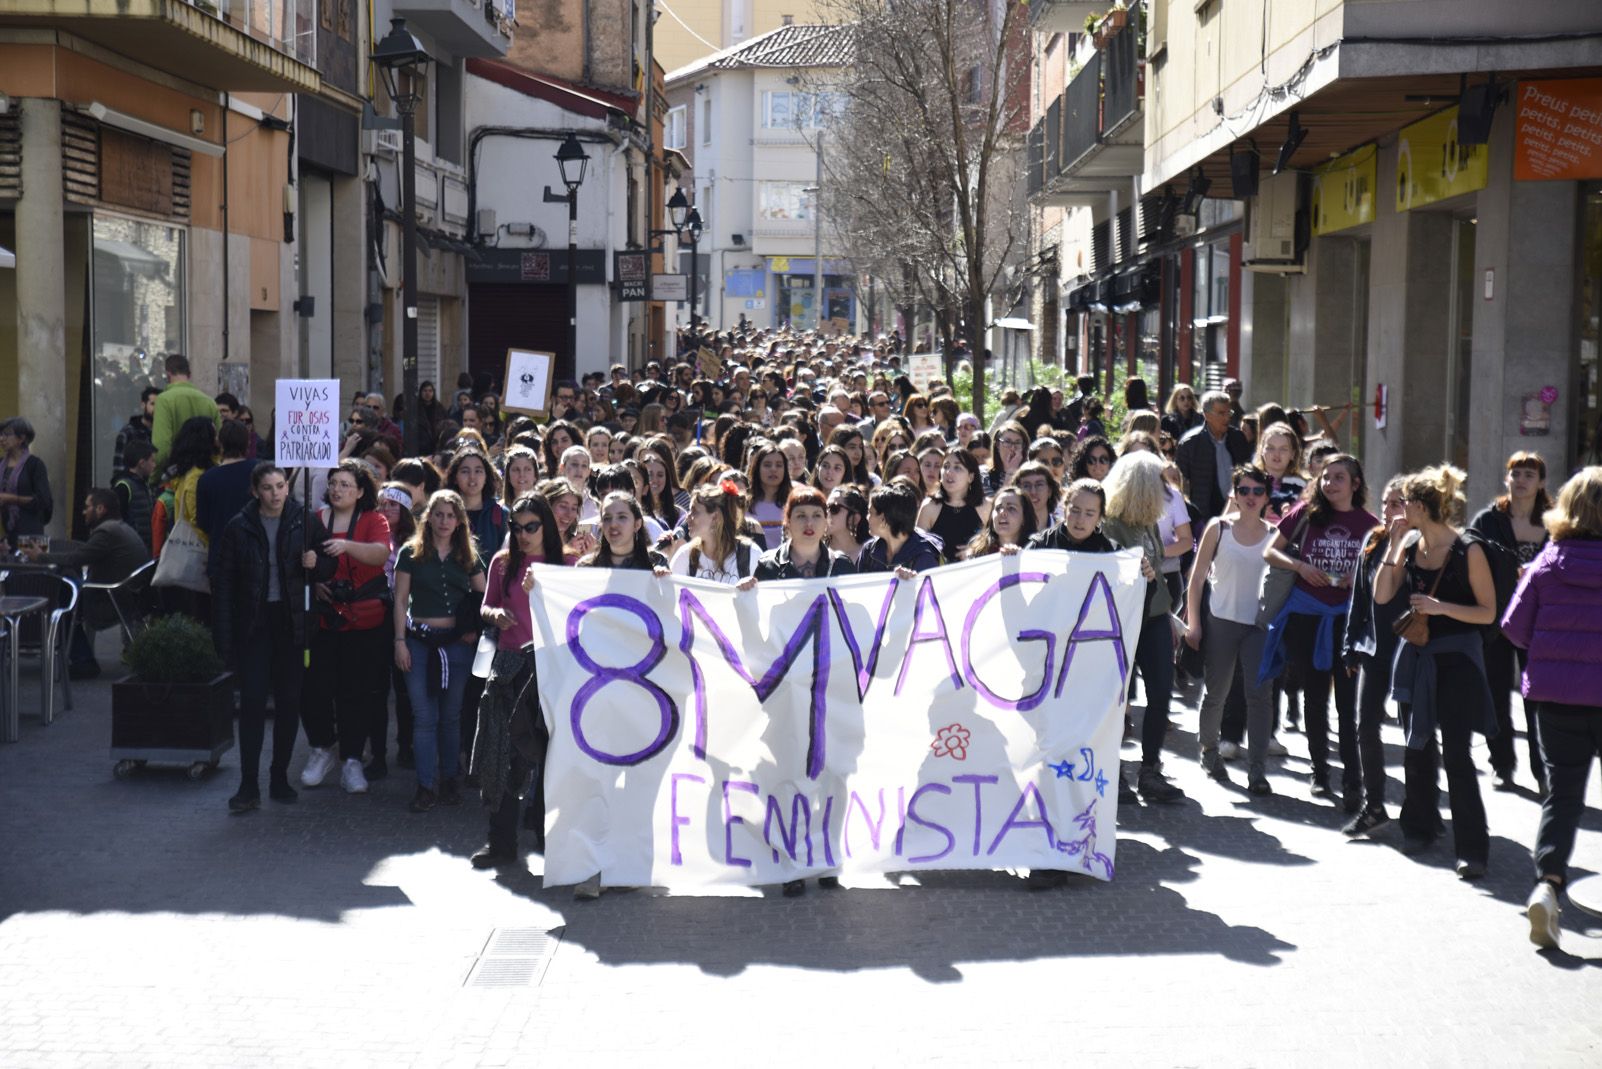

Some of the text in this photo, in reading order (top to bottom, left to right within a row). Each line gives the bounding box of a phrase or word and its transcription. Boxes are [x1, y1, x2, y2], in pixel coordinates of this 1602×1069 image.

[1523, 86, 1568, 113] Preus
[622, 287, 645, 298] PAN
[290, 387, 329, 401] VIVAS
[290, 424, 320, 435] CONTRA
[280, 441, 331, 461] PATRIARCADO
[1325, 548, 1347, 558] CLAU
[828, 571, 1129, 711] VAGA
[670, 773, 1057, 868] FEMINISTA
